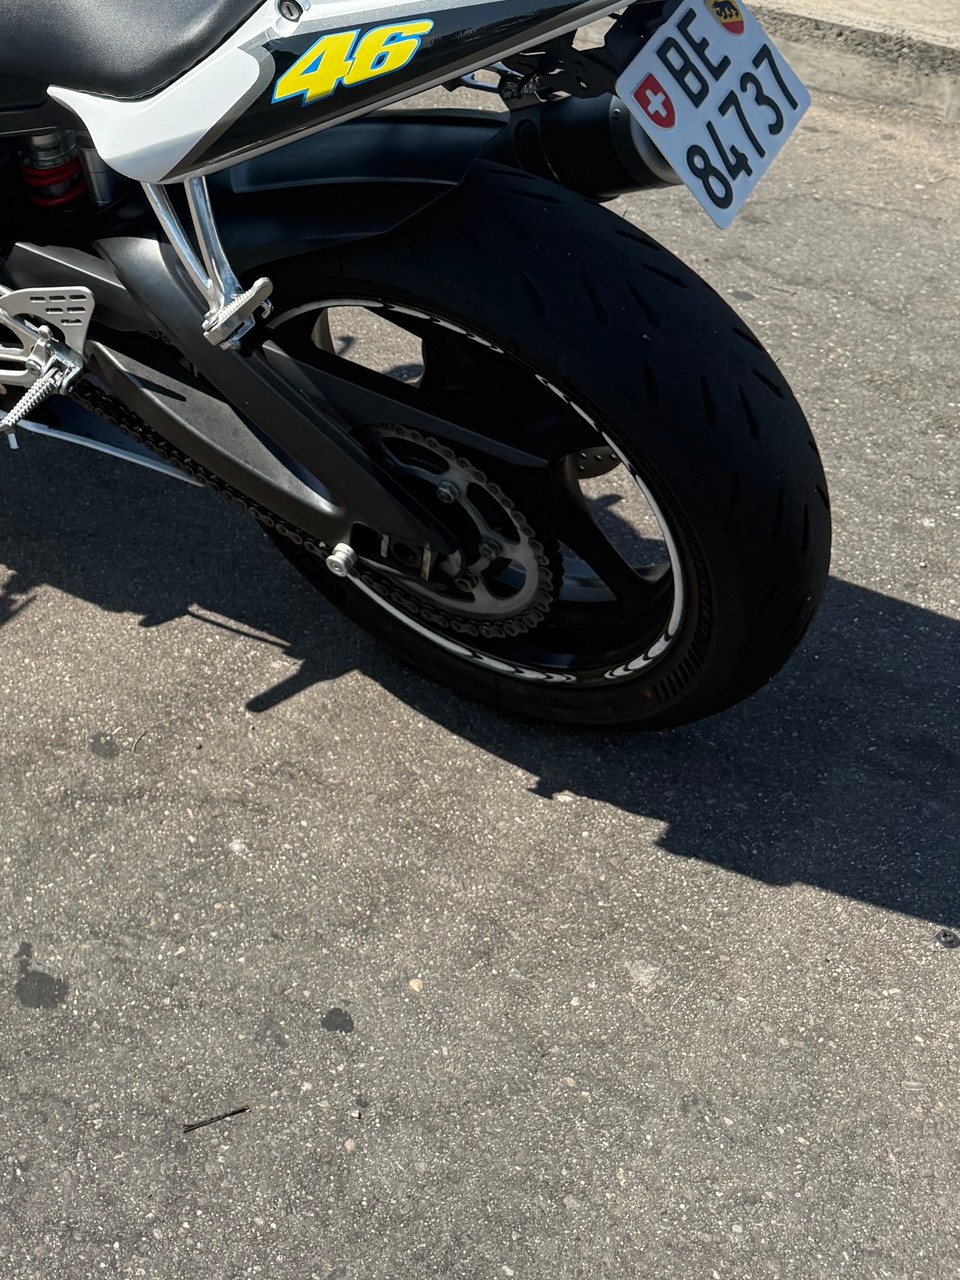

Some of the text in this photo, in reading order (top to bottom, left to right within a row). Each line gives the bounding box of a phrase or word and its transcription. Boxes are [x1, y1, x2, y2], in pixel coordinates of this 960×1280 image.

[271, 19, 435, 108] 46
[656, 7, 731, 109] BE
[686, 44, 798, 210] 84737
